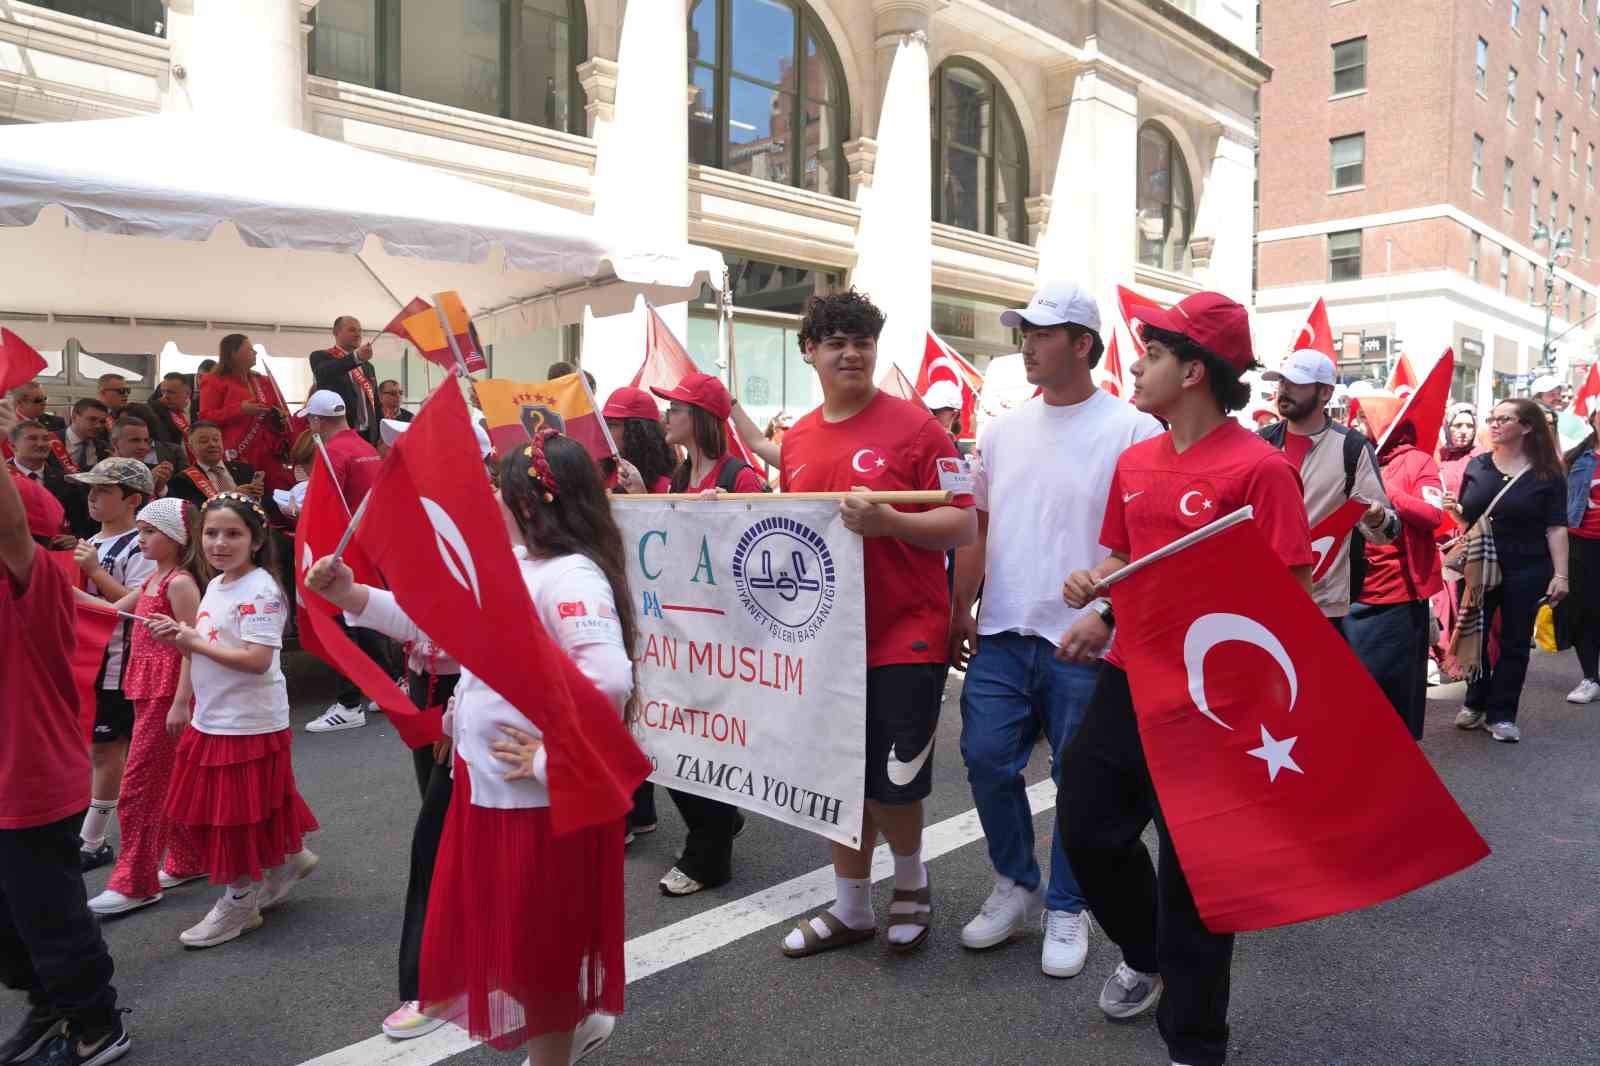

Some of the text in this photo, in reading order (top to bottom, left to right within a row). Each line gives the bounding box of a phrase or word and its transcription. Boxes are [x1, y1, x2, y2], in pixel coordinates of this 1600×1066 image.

[642, 590, 663, 619] PA
[634, 633, 804, 695] AN MUSLIM
[675, 753, 755, 797] TAMCA
[761, 775, 844, 826] YOUTH
